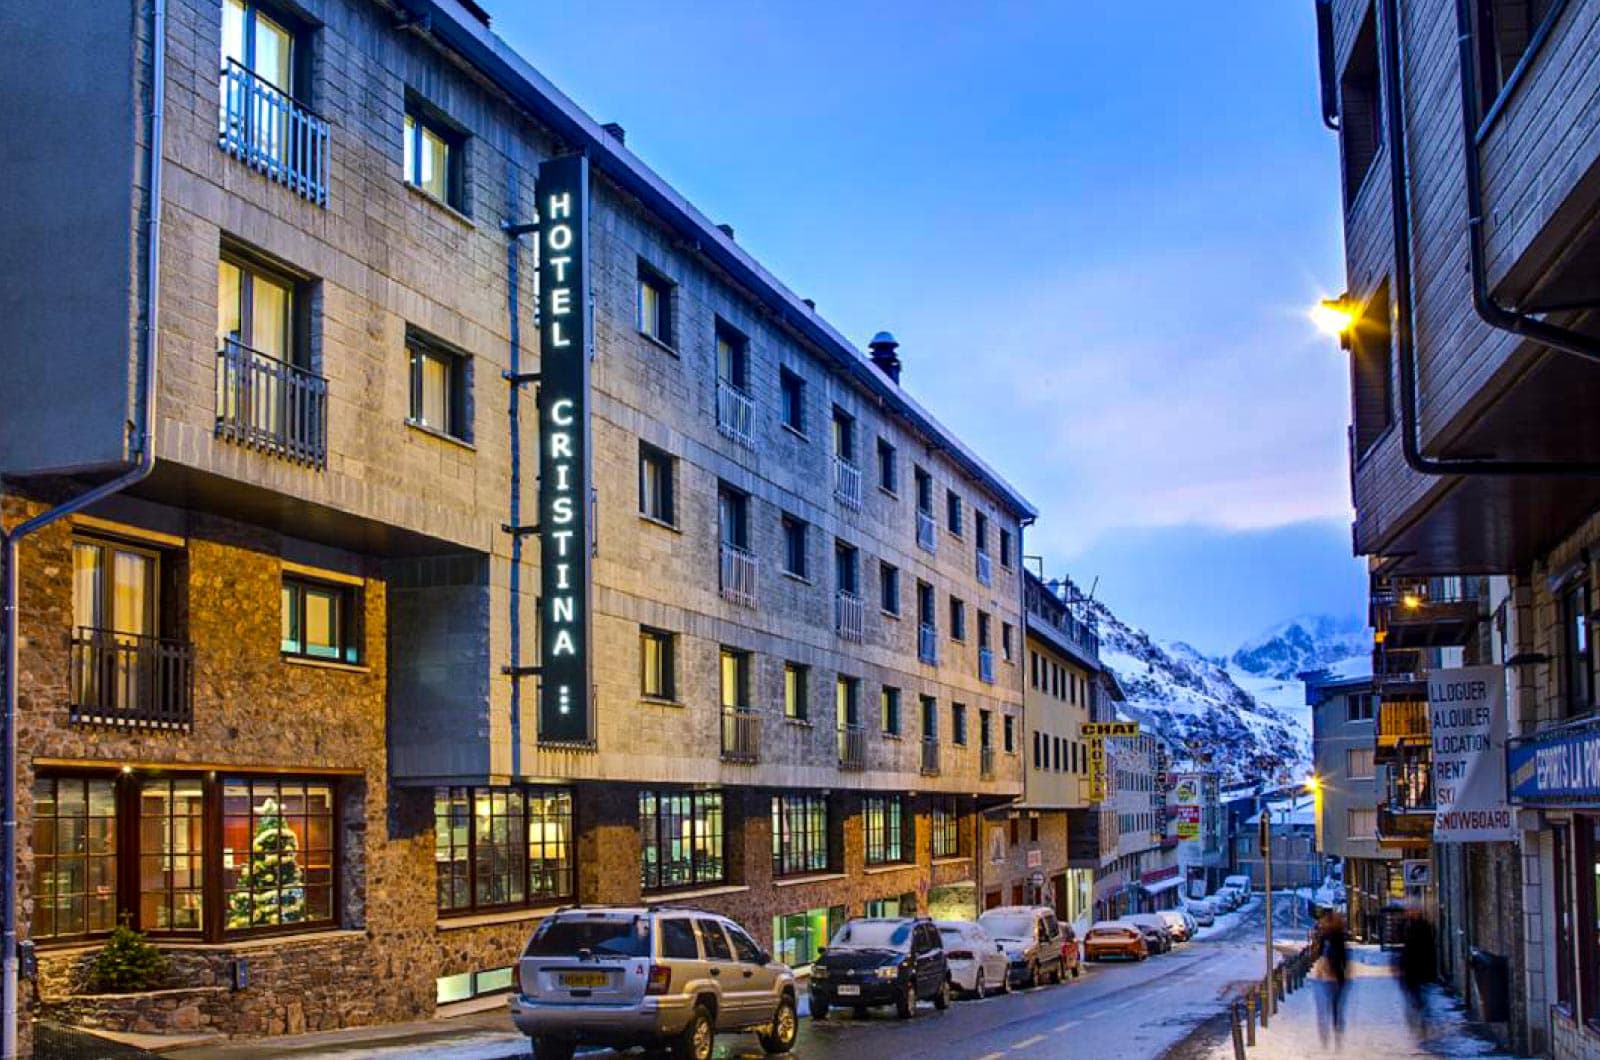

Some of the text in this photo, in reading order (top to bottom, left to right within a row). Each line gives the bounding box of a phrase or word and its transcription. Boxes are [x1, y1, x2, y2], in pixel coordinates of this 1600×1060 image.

[549, 192, 575, 655] HOTEL CRISTINA
[1431, 681, 1486, 702] LLOGUER
[1435, 735, 1490, 754] LOCATION
[1438, 761, 1467, 780] RENT
[1436, 811, 1510, 830] SNOWBOARD
